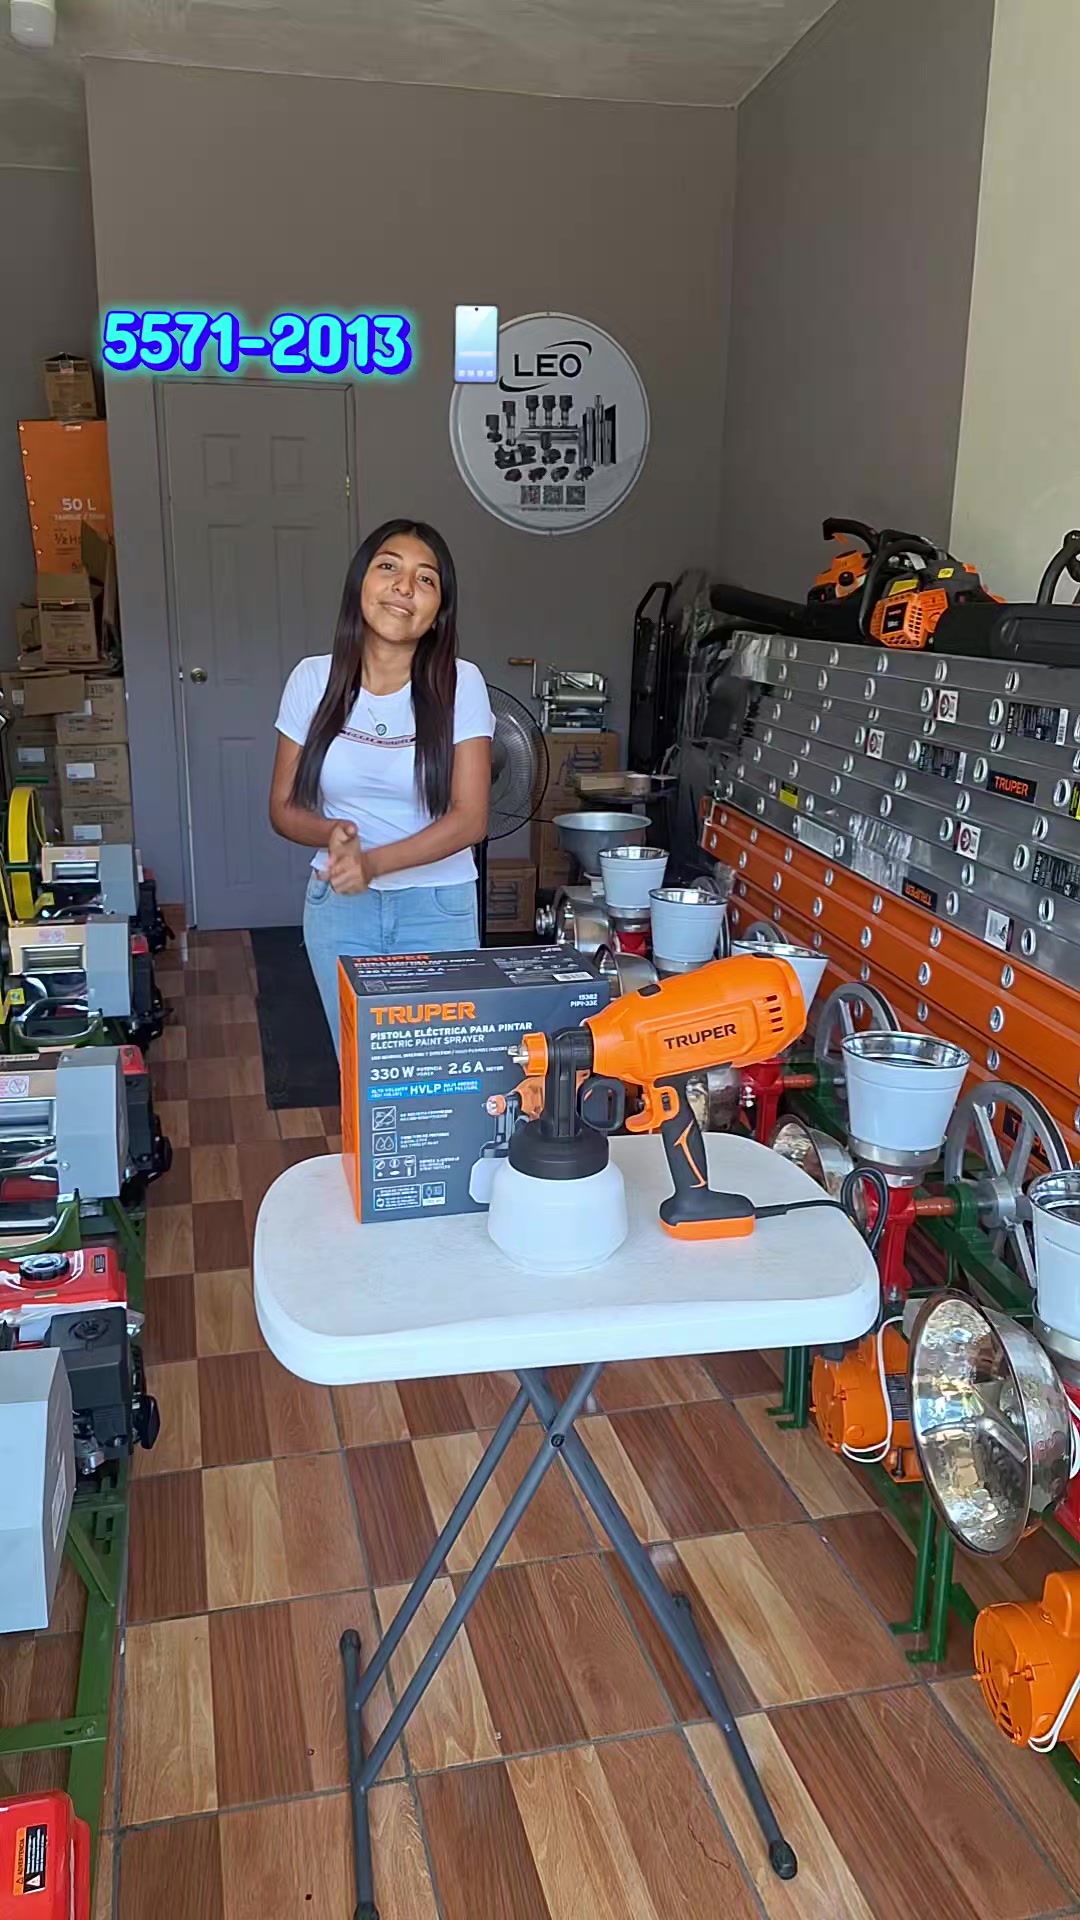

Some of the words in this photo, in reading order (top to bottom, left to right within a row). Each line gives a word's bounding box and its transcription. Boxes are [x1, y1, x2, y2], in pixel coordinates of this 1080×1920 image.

[513, 353, 583, 379] LEO
[62, 498, 83, 511] 50
[87, 498, 97, 511] L
[994, 775, 1029, 797] TRUPER
[370, 1002, 476, 1026] TRUPER
[370, 1031, 412, 1042] PISTOLA
[414, 1025, 467, 1038] ELÉCTRICA
[469, 1024, 495, 1034] PARA
[499, 1022, 533, 1032] PINTAR
[663, 1023, 737, 1050] TRUPER
[370, 1039, 414, 1050] ELECTRIC
[415, 1037, 441, 1047] PAINT
[444, 1034, 485, 1045] SPRAYER
[370, 1067, 400, 1081] 330
[402, 1066, 415, 1078] W
[448, 1061, 472, 1075] 2.6
[473, 1060, 484, 1073] A
[410, 1083, 442, 1095] HVLP
